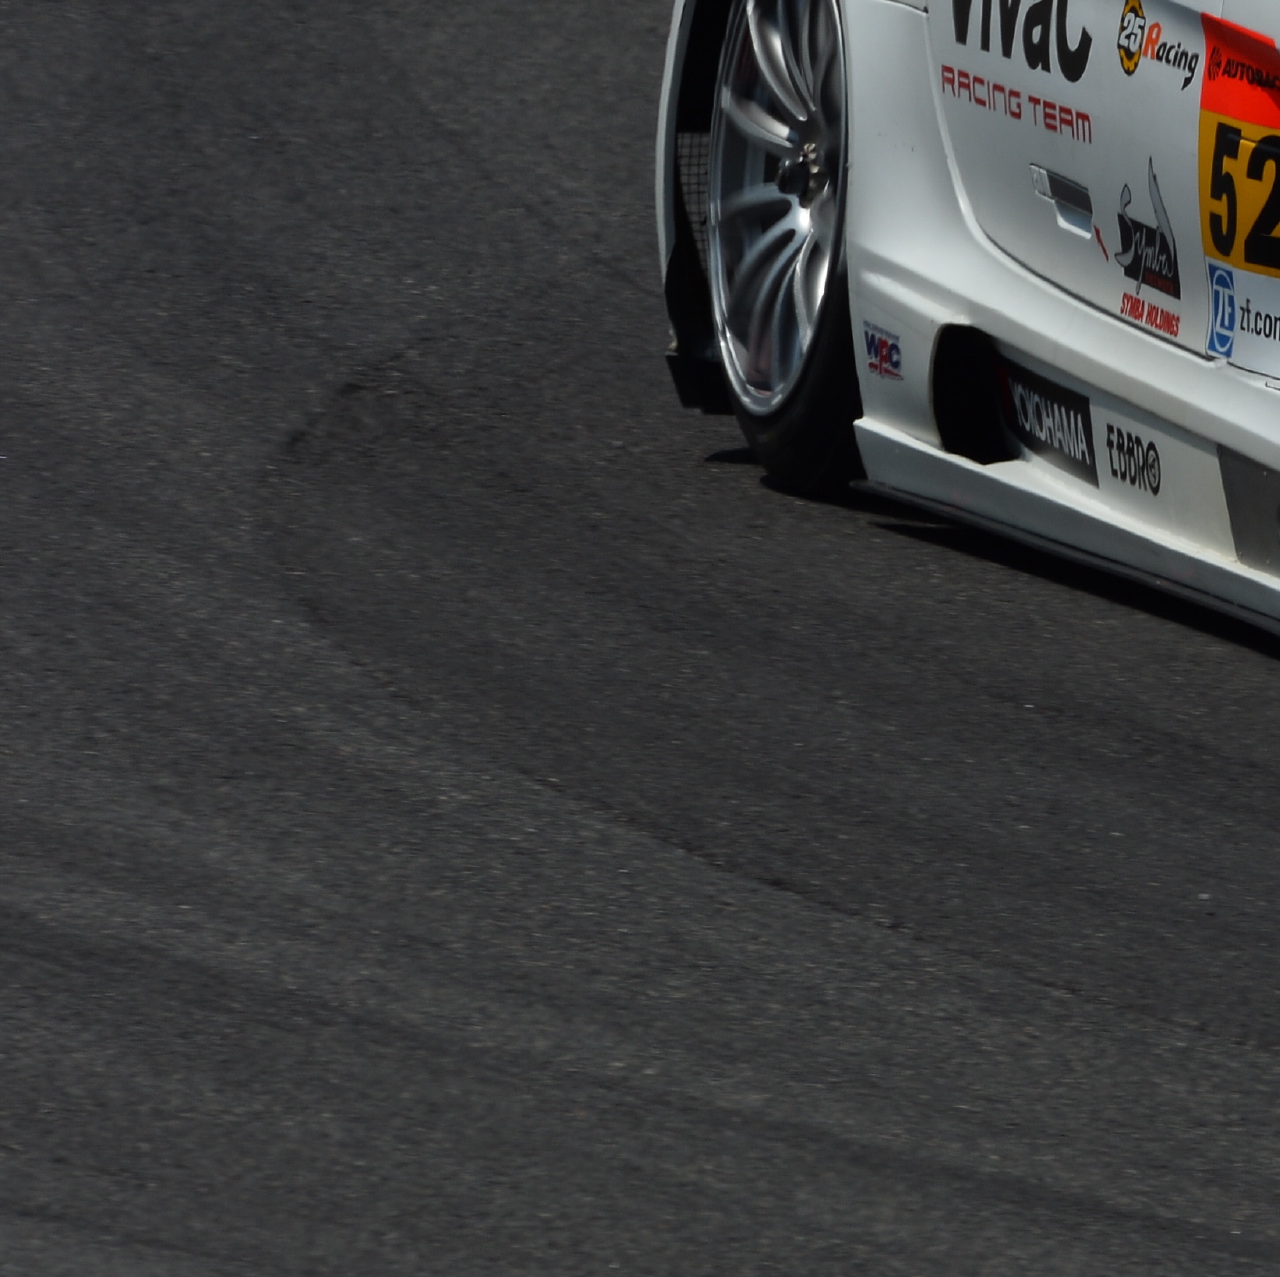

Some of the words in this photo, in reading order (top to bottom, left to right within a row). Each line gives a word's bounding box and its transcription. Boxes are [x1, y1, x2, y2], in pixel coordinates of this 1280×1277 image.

[1119, 8, 1146, 54] 25
[1143, 22, 1200, 91] Racing
[941, 64, 1022, 120] RACING
[1027, 95, 1093, 144] TEAM
[1120, 292, 1145, 323] SYMBA
[1144, 302, 1181, 338] HOLDINGS
[1212, 284, 1234, 334] ZF
[1008, 377, 1090, 465] YOKOHAMA
[1106, 422, 1161, 496] EBBRO
